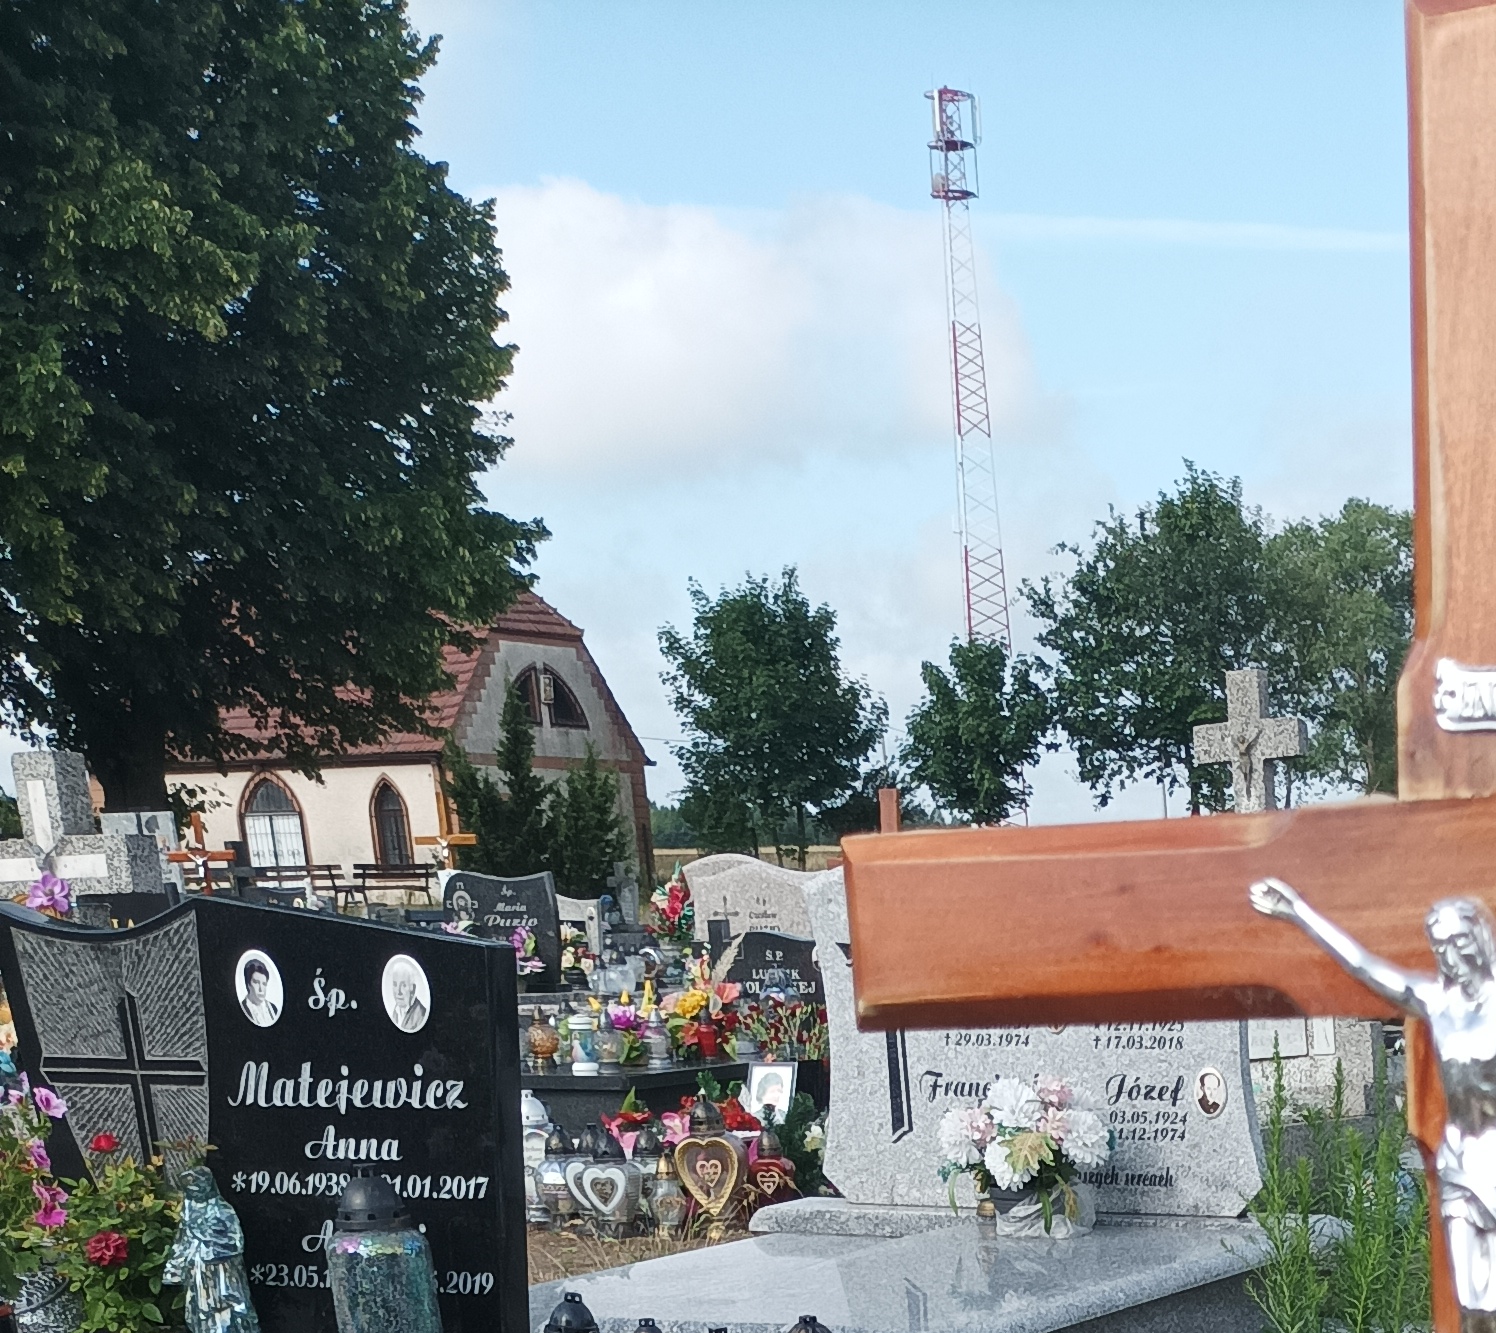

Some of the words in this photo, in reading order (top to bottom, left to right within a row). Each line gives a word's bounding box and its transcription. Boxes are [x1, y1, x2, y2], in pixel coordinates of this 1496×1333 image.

[484, 914, 538, 927] Puzio
[1106, 1036, 1184, 1050] 17.03.2018
[227, 1061, 469, 1114] Matejewicz
[1106, 1073, 1185, 1106] Józef
[304, 1125, 403, 1161] Anna
